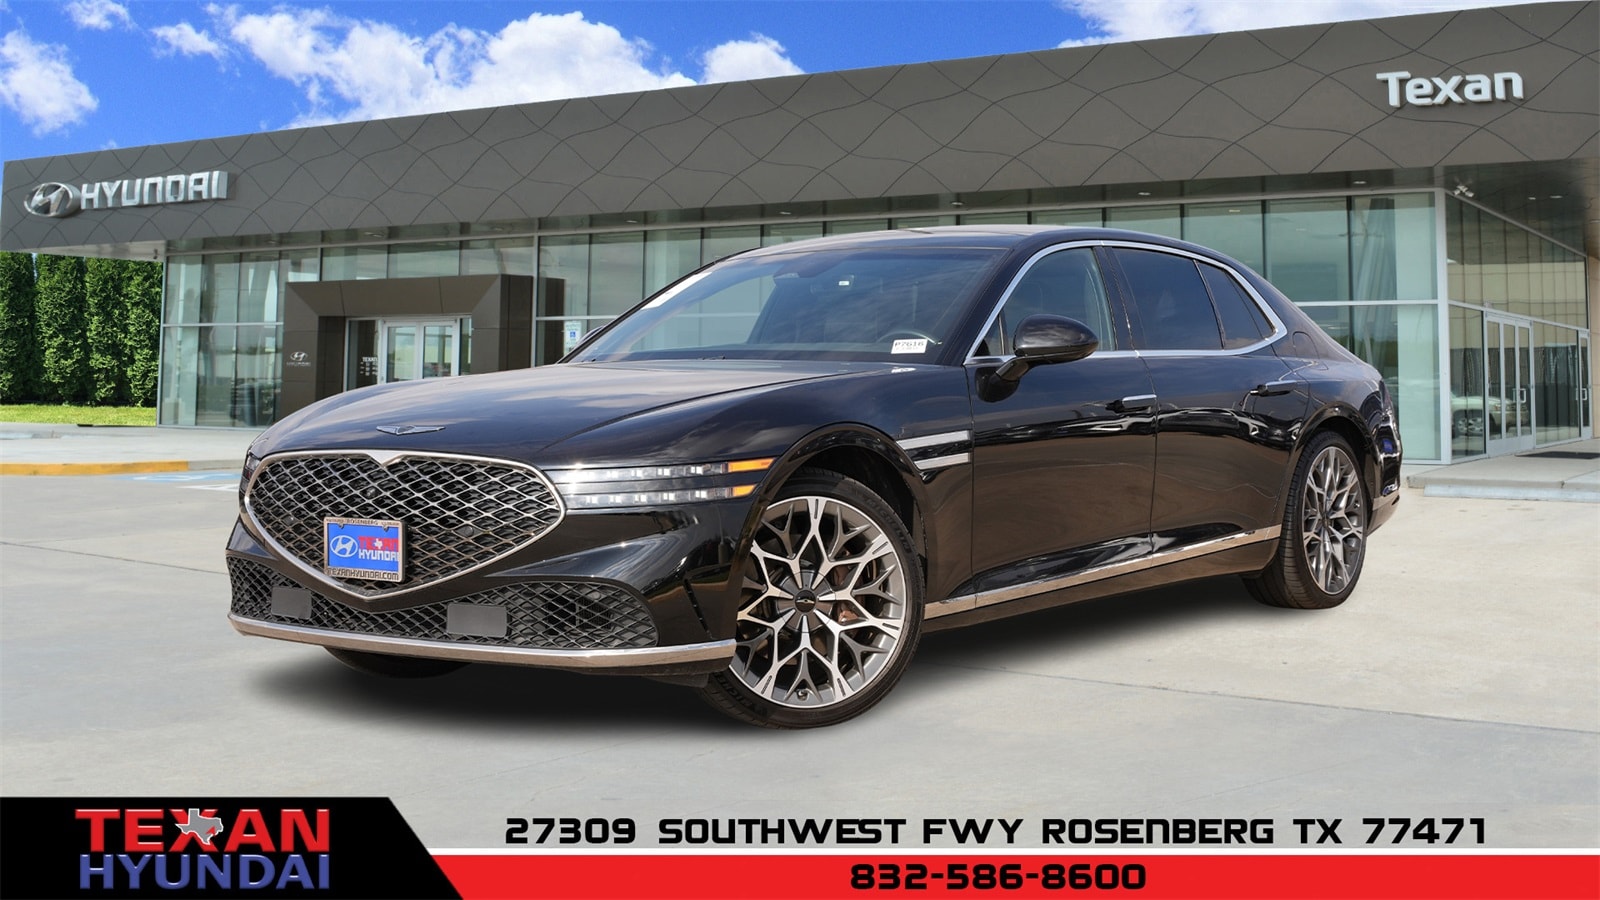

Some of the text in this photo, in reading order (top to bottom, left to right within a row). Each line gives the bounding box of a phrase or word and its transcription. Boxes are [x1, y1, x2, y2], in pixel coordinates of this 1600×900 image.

[1376, 71, 1524, 108] Texan
[80, 170, 228, 210] HYUNDAI
[328, 567, 399, 580] TEXANHYUNDAI.COM
